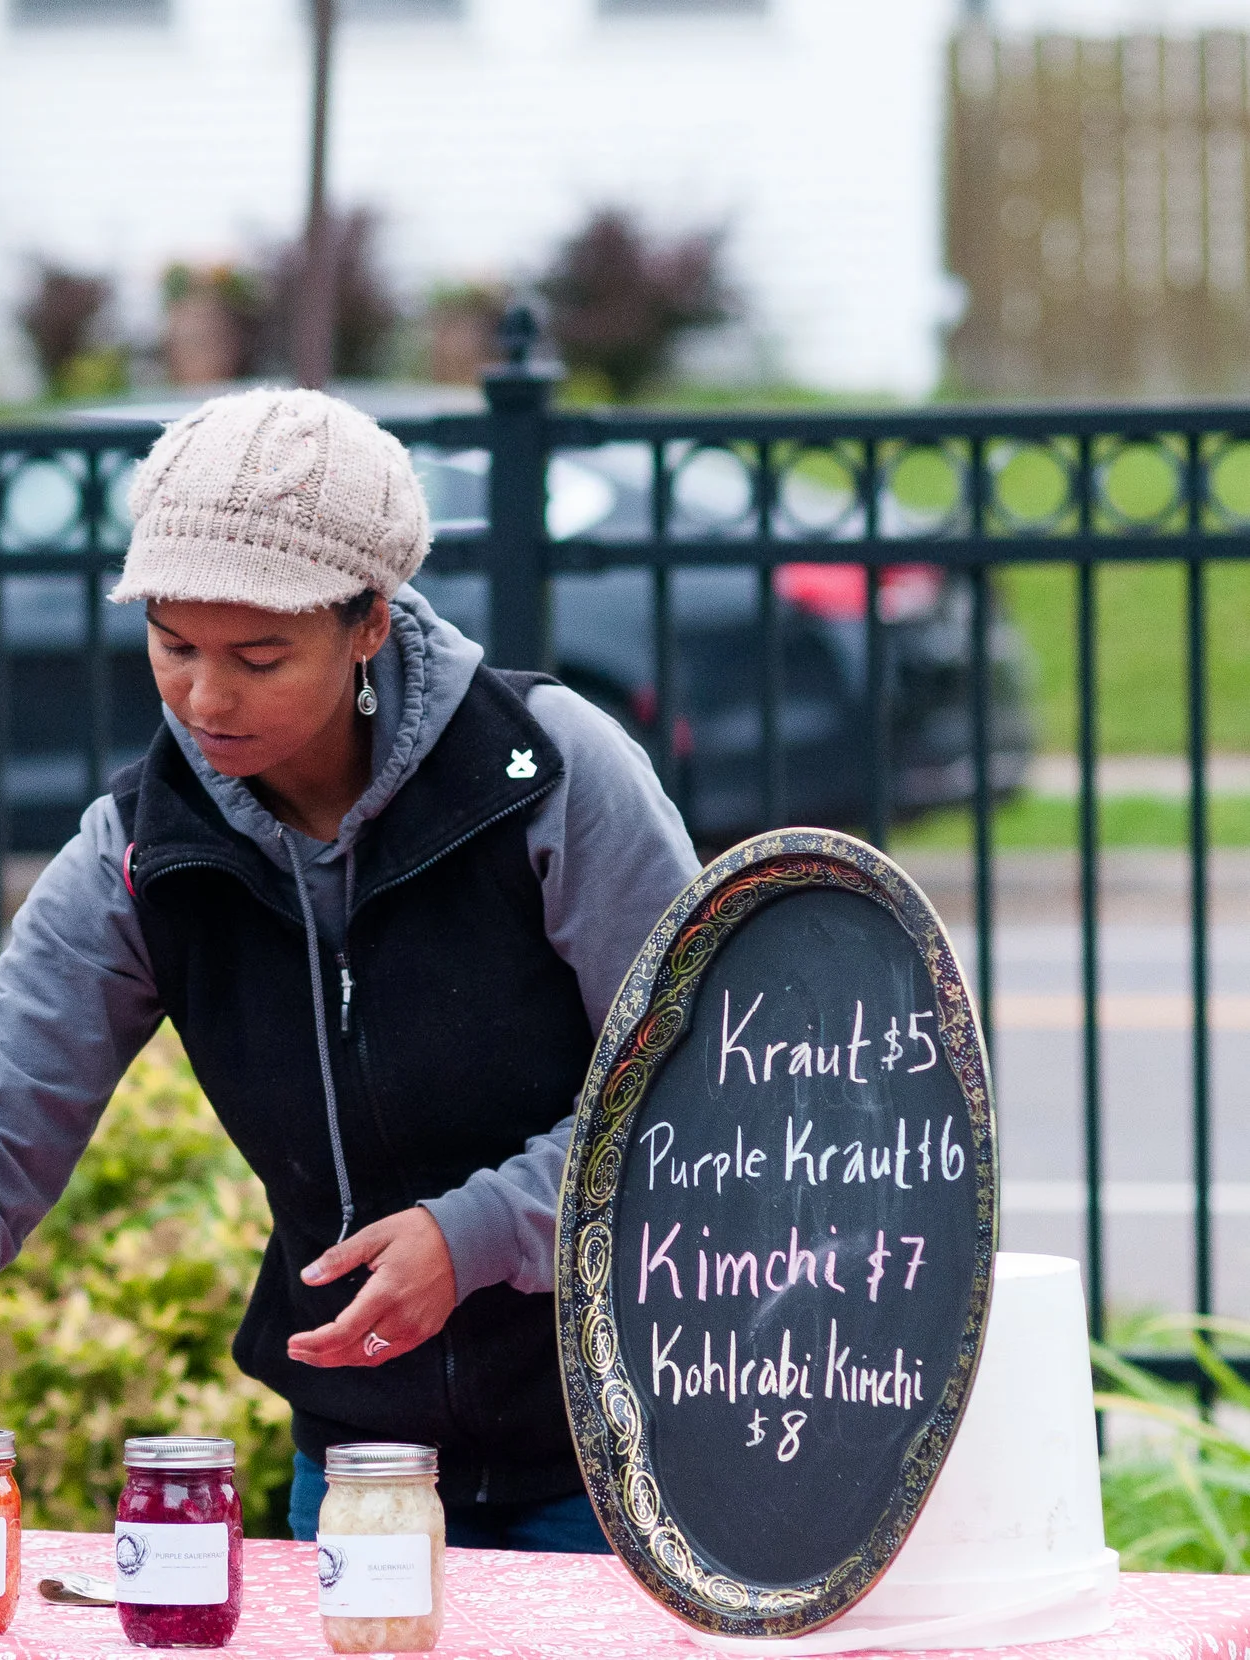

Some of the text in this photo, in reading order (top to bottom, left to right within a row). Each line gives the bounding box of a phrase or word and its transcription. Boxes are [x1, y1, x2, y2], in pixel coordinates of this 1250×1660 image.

[719, 989, 937, 1085] Kraut $5
[640, 1121, 767, 1195] Purple
[784, 1115, 912, 1189] Kraut
[638, 1222, 927, 1304] Kimchi $7
[653, 1318, 924, 1410] Kohlrabi Kimchi
[746, 1408, 808, 1462] $8
[155, 1551, 226, 1560] PURPLE SAUERKRAUT
